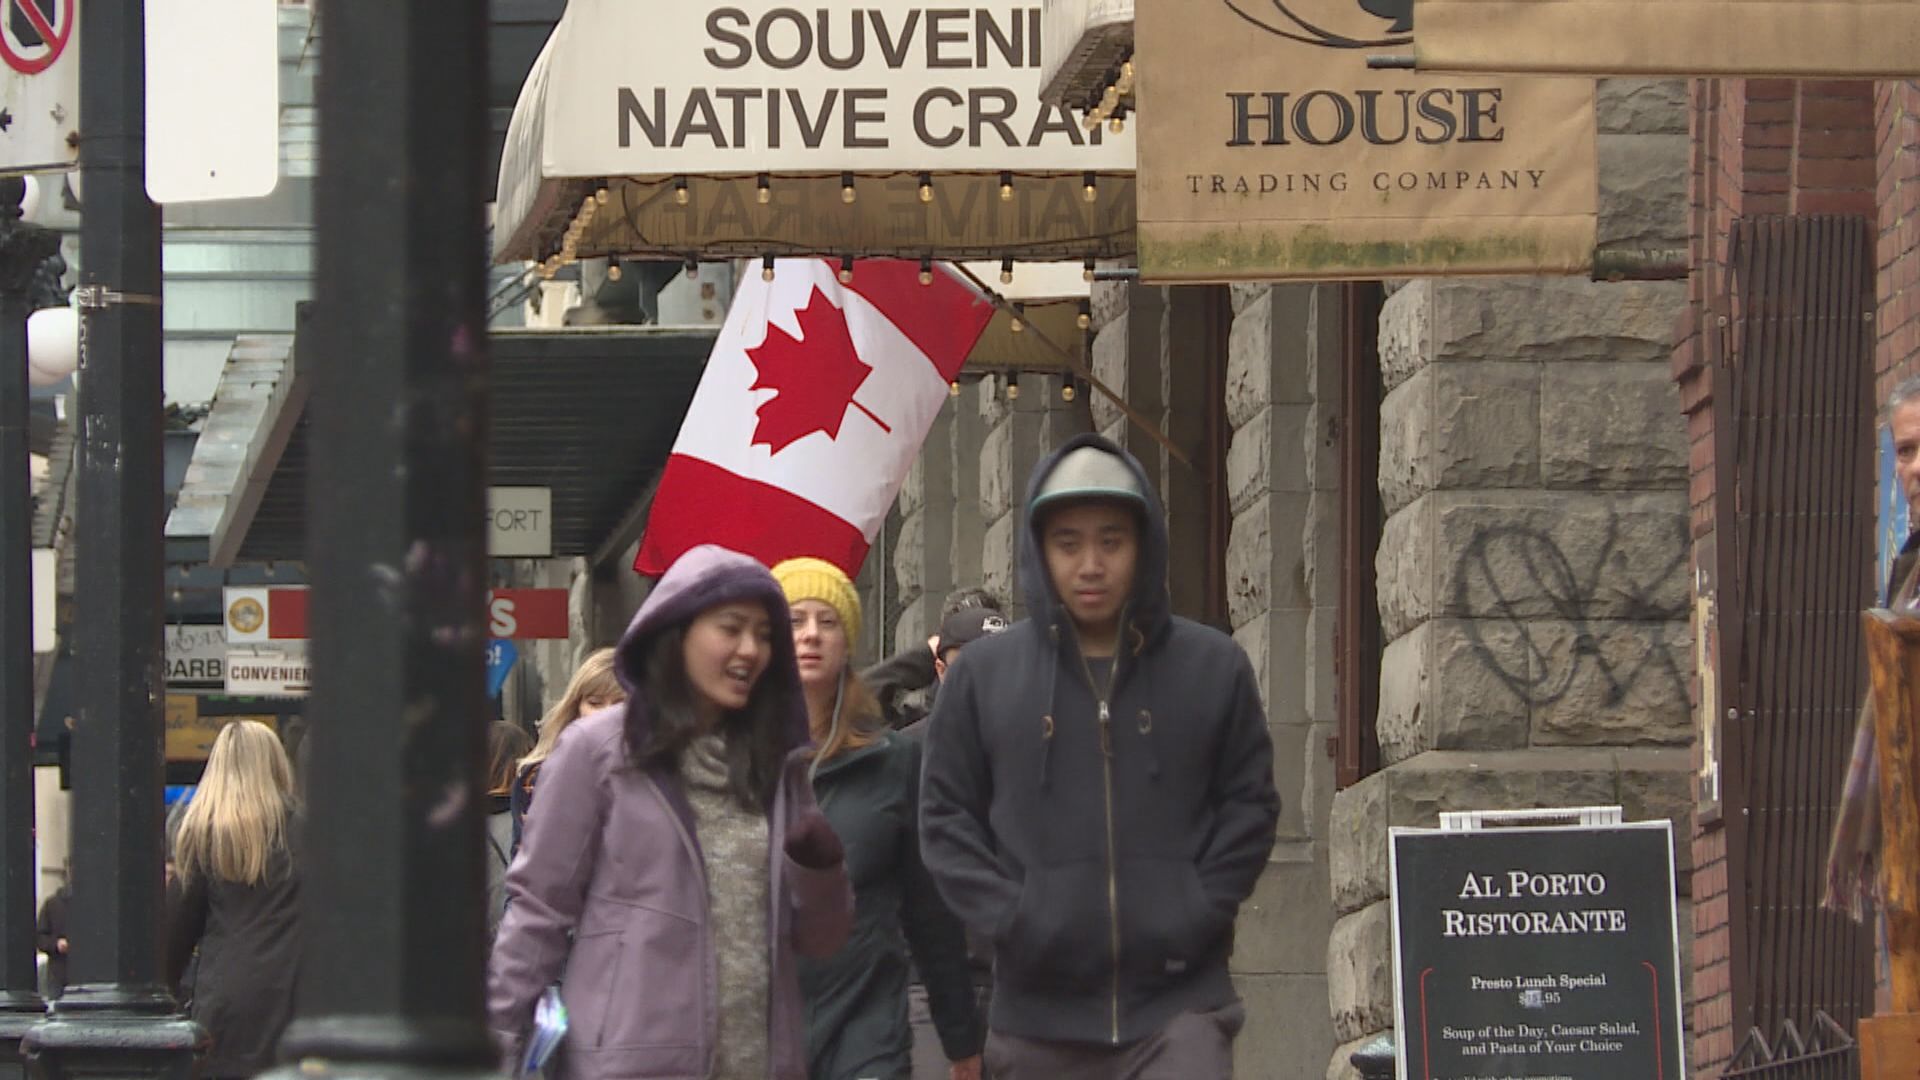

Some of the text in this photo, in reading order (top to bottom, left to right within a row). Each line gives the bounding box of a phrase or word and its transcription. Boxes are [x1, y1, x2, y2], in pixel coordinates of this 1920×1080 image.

[704, 7, 1041, 70] SOUVENI
[618, 87, 888, 148] NATIVE
[1225, 87, 1504, 147] HOUSE
[1187, 169, 1546, 193] TRADING COMPANY
[1459, 871, 1606, 898] AL PORTO
[1442, 909, 1627, 937] RISTORANTE
[1471, 973, 1607, 990] Presto Lunch Special
[1442, 1022, 1640, 1041] Soup of the Day, Caesar Salad,
[1461, 1039, 1623, 1056] and Pasta of Your Choice
